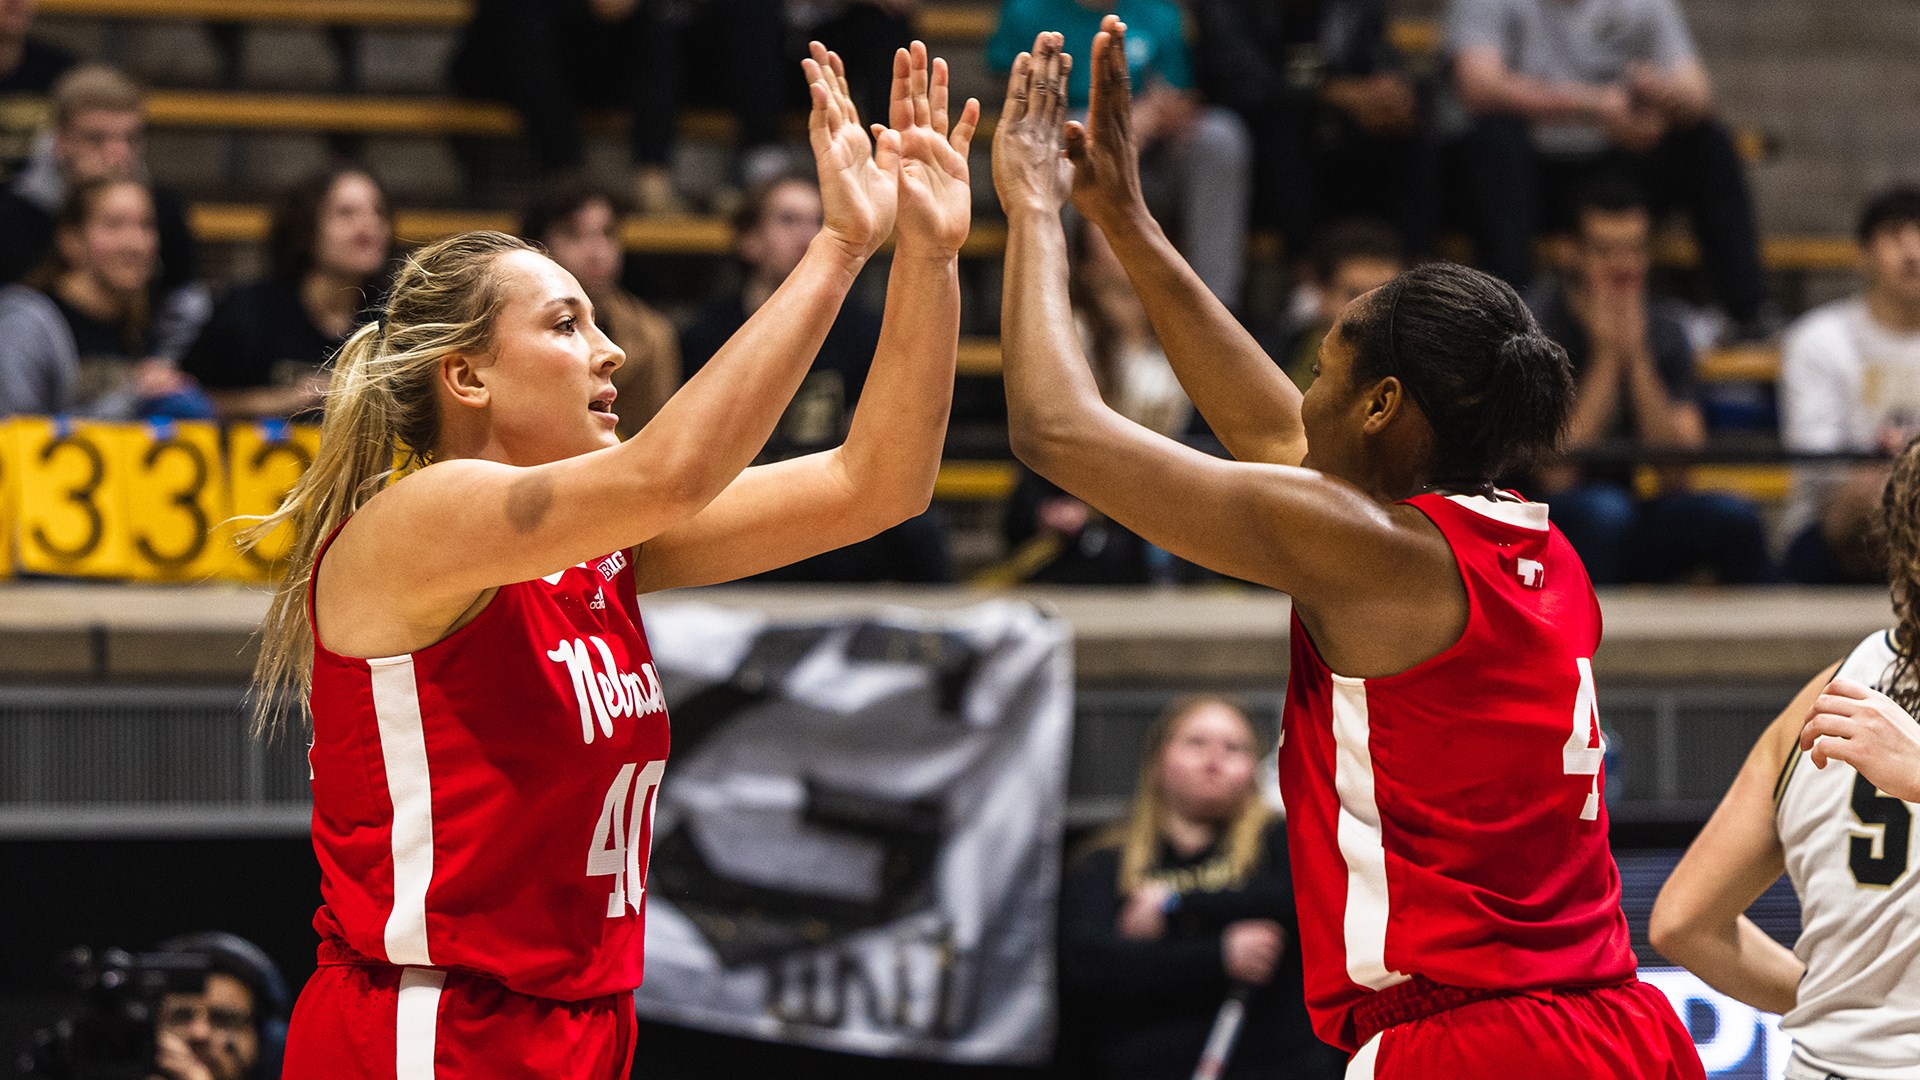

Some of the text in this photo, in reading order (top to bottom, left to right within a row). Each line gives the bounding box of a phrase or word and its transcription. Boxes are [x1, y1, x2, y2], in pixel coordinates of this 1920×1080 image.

[31, 436, 104, 563] 3
[135, 437, 208, 568] 3
[586, 759, 666, 919] 40
